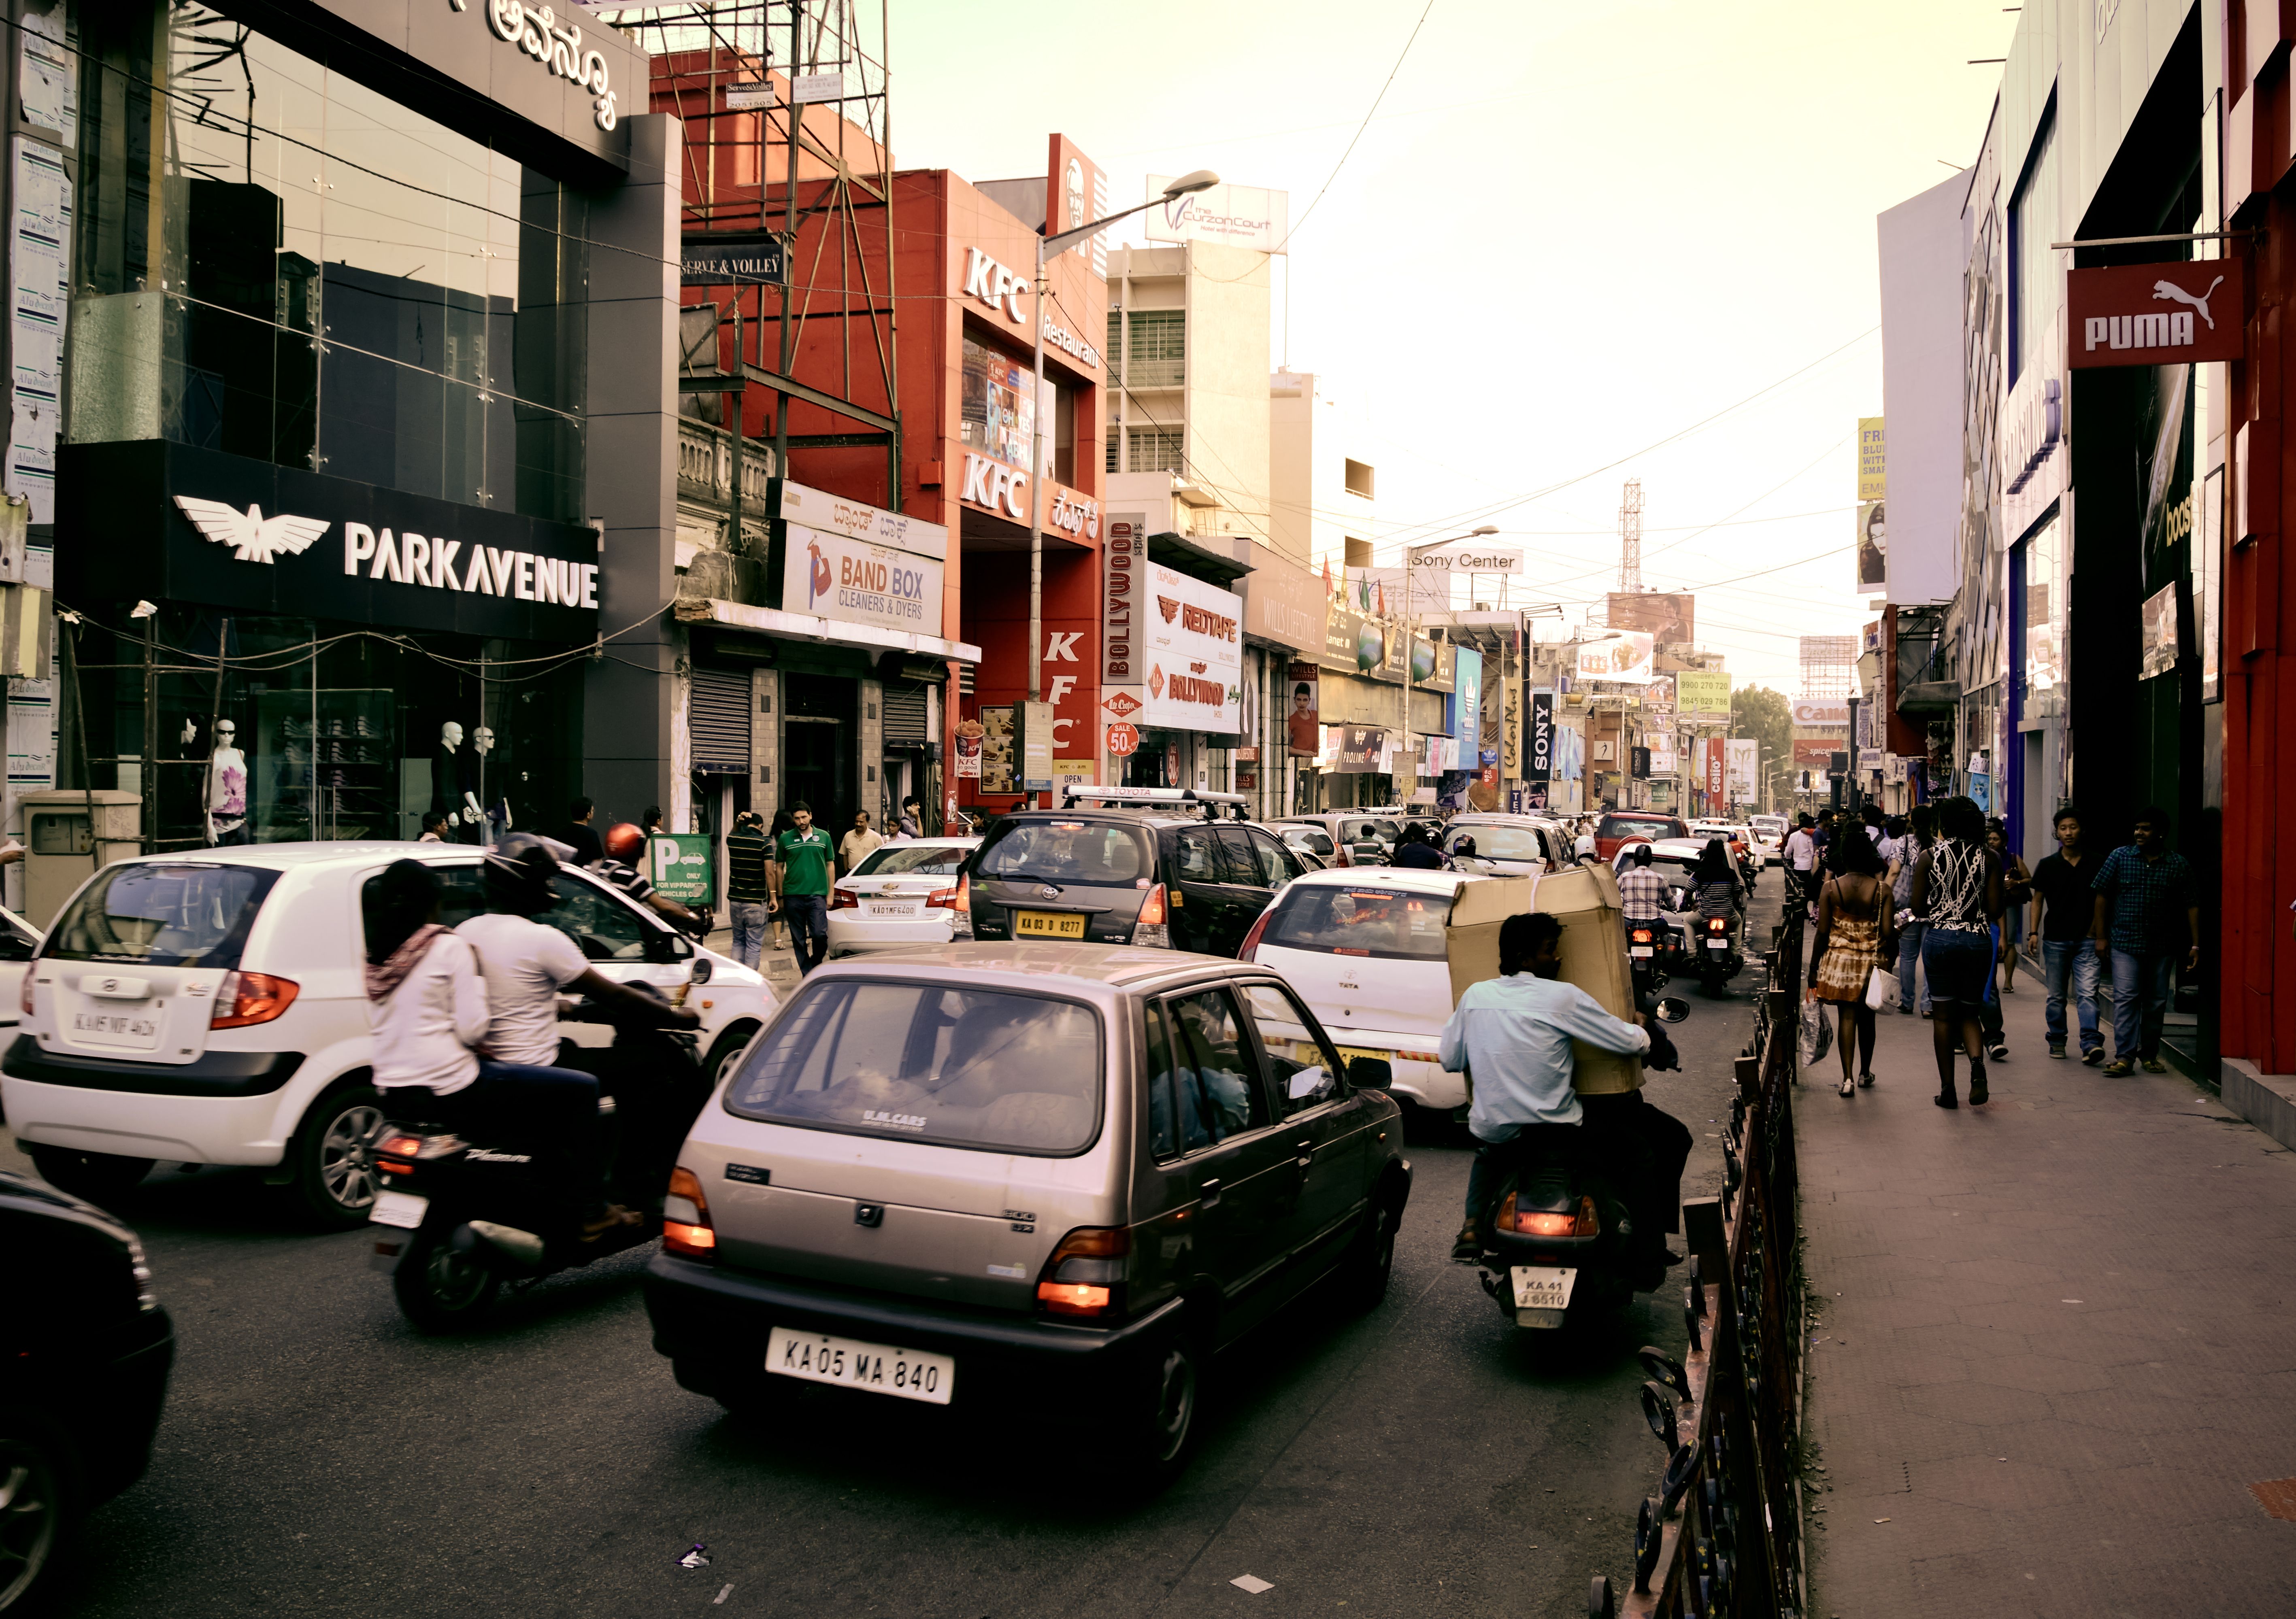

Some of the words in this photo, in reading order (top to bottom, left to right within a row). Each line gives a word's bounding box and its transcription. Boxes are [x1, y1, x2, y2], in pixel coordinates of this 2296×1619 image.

[1228, 228, 1255, 236] difference
[681, 259, 717, 276] SERVE
[719, 259, 728, 274] &
[732, 258, 780, 273] VOLLEY
[963, 246, 1027, 324] KFC
[1043, 314, 1099, 369] Restaurant
[2085, 311, 2194, 351] PUMA
[1018, 414, 1030, 434] YES
[961, 452, 1026, 518] KFC
[1412, 555, 1453, 570] Sony
[1460, 553, 1515, 567] Center
[841, 556, 887, 592] BAND
[892, 567, 923, 600] BOX
[839, 589, 884, 613] CLEANERS
[887, 599, 893, 614] &
[896, 600, 922, 620] DYERS
[1108, 522, 1133, 676] BOLLYWOOD
[1182, 603, 1237, 643] REDTAPE
[1263, 596, 1285, 634] WILLS
[1287, 606, 1315, 645] LIFESTYLE
[1169, 673, 1224, 706] BOLLYWOOD
[1681, 681, 1698, 689] 9900
[1681, 697, 1698, 705] 9845
[1534, 703, 1549, 771] SONY
[1343, 751, 1365, 763] PROLINE
[1064, 775, 1082, 783] OPEN
[1114, 788, 1151, 796] TOYOTA
[1710, 761, 1721, 793] cello
[655, 838, 680, 881] P
[1021, 918, 1031, 929] KA
[1034, 919, 1043, 930] 03
[1526, 1281, 1545, 1290] KA
[1549, 1281, 1562, 1291] 41
[784, 1340, 811, 1371] KA
[817, 1347, 845, 1376] 05
[856, 1353, 883, 1385] MA
[895, 1362, 938, 1394] 840
